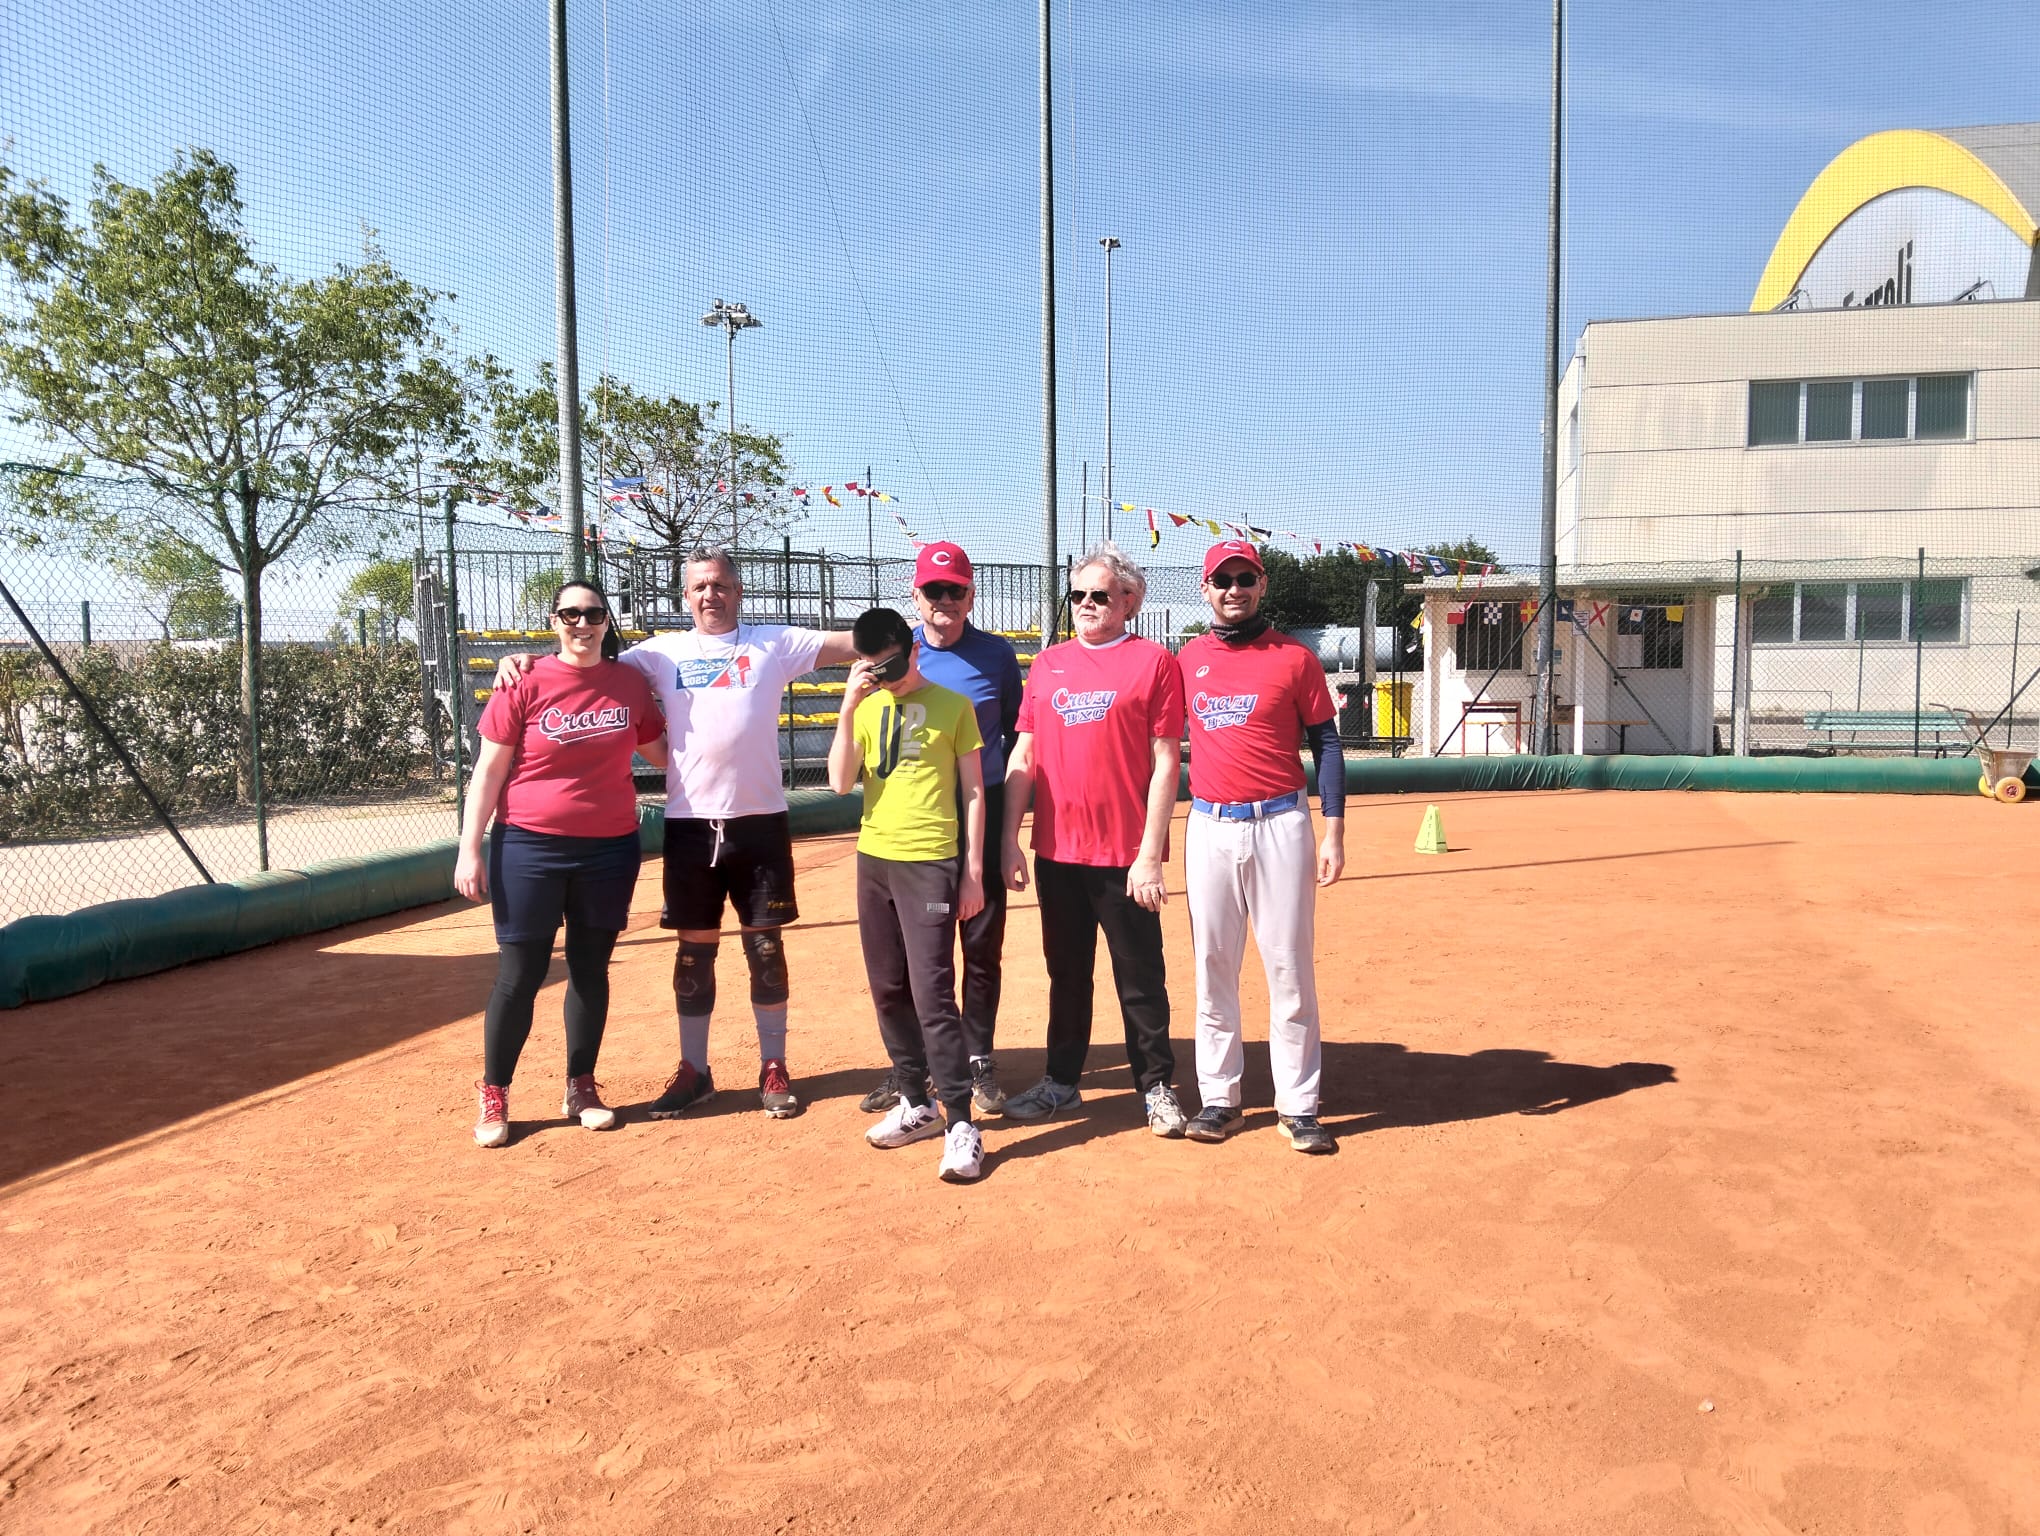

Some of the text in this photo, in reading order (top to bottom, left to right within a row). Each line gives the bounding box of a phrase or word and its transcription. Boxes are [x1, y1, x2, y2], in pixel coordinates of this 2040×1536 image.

[930, 550, 951, 566] C
[682, 674, 709, 687] 2025
[1051, 687, 1117, 711] Crazy
[1192, 691, 1259, 716] Crazy
[539, 706, 630, 736] Crazy
